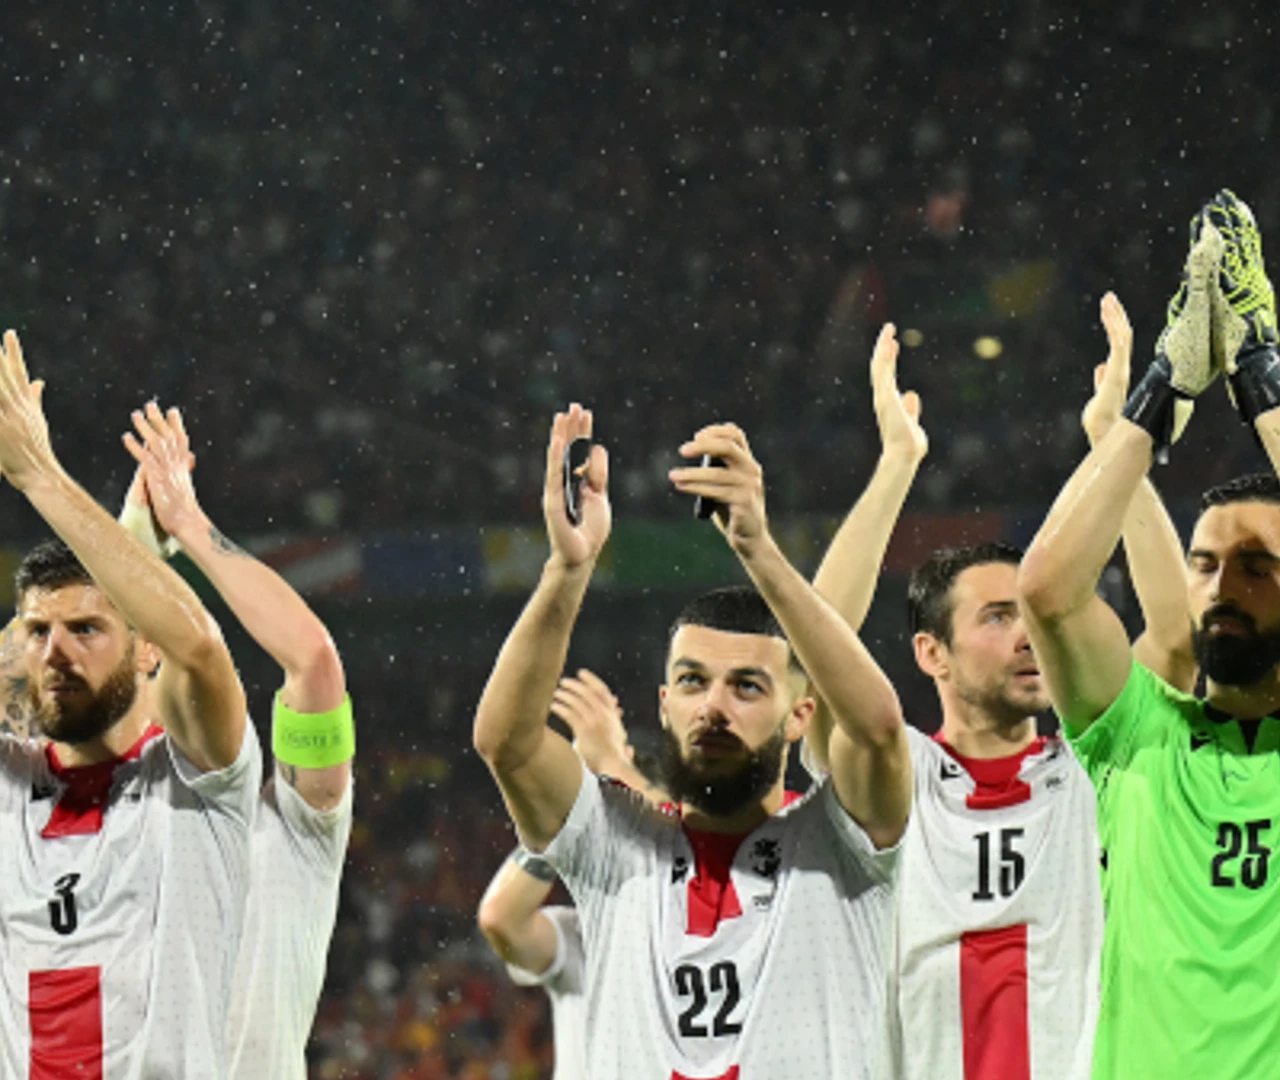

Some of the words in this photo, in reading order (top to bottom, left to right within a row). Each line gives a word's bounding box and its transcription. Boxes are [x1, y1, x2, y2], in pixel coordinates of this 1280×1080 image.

[972, 827, 1026, 902] 15
[1211, 818, 1272, 890] 25
[48, 873, 81, 935] 3
[675, 959, 742, 1038] 22
